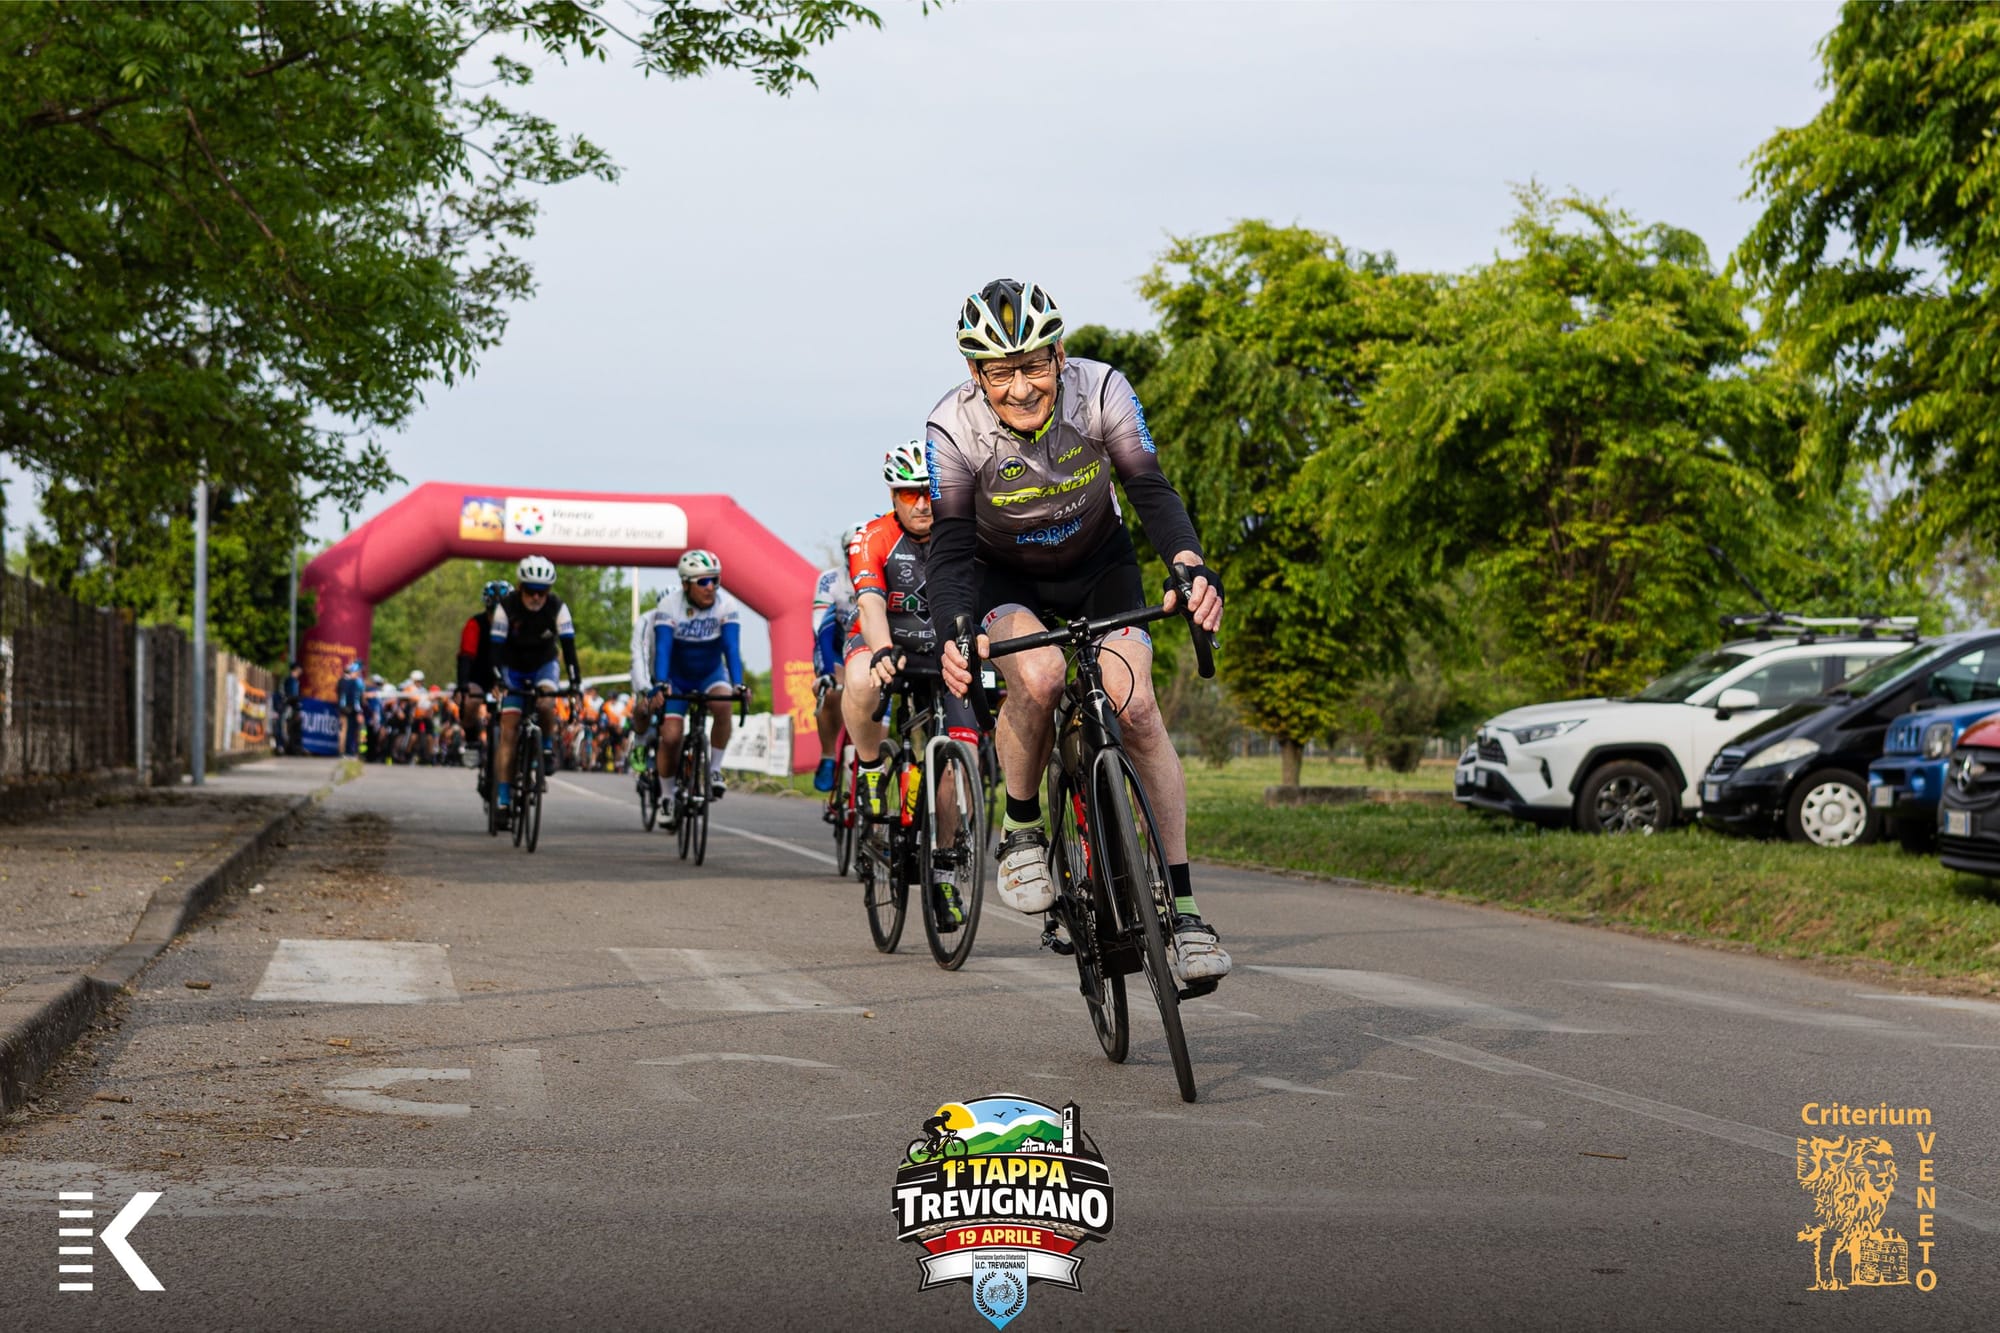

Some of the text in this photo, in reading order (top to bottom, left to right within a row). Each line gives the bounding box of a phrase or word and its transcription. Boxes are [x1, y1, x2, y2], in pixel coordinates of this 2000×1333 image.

[551, 523, 665, 540] The Land of Venice
